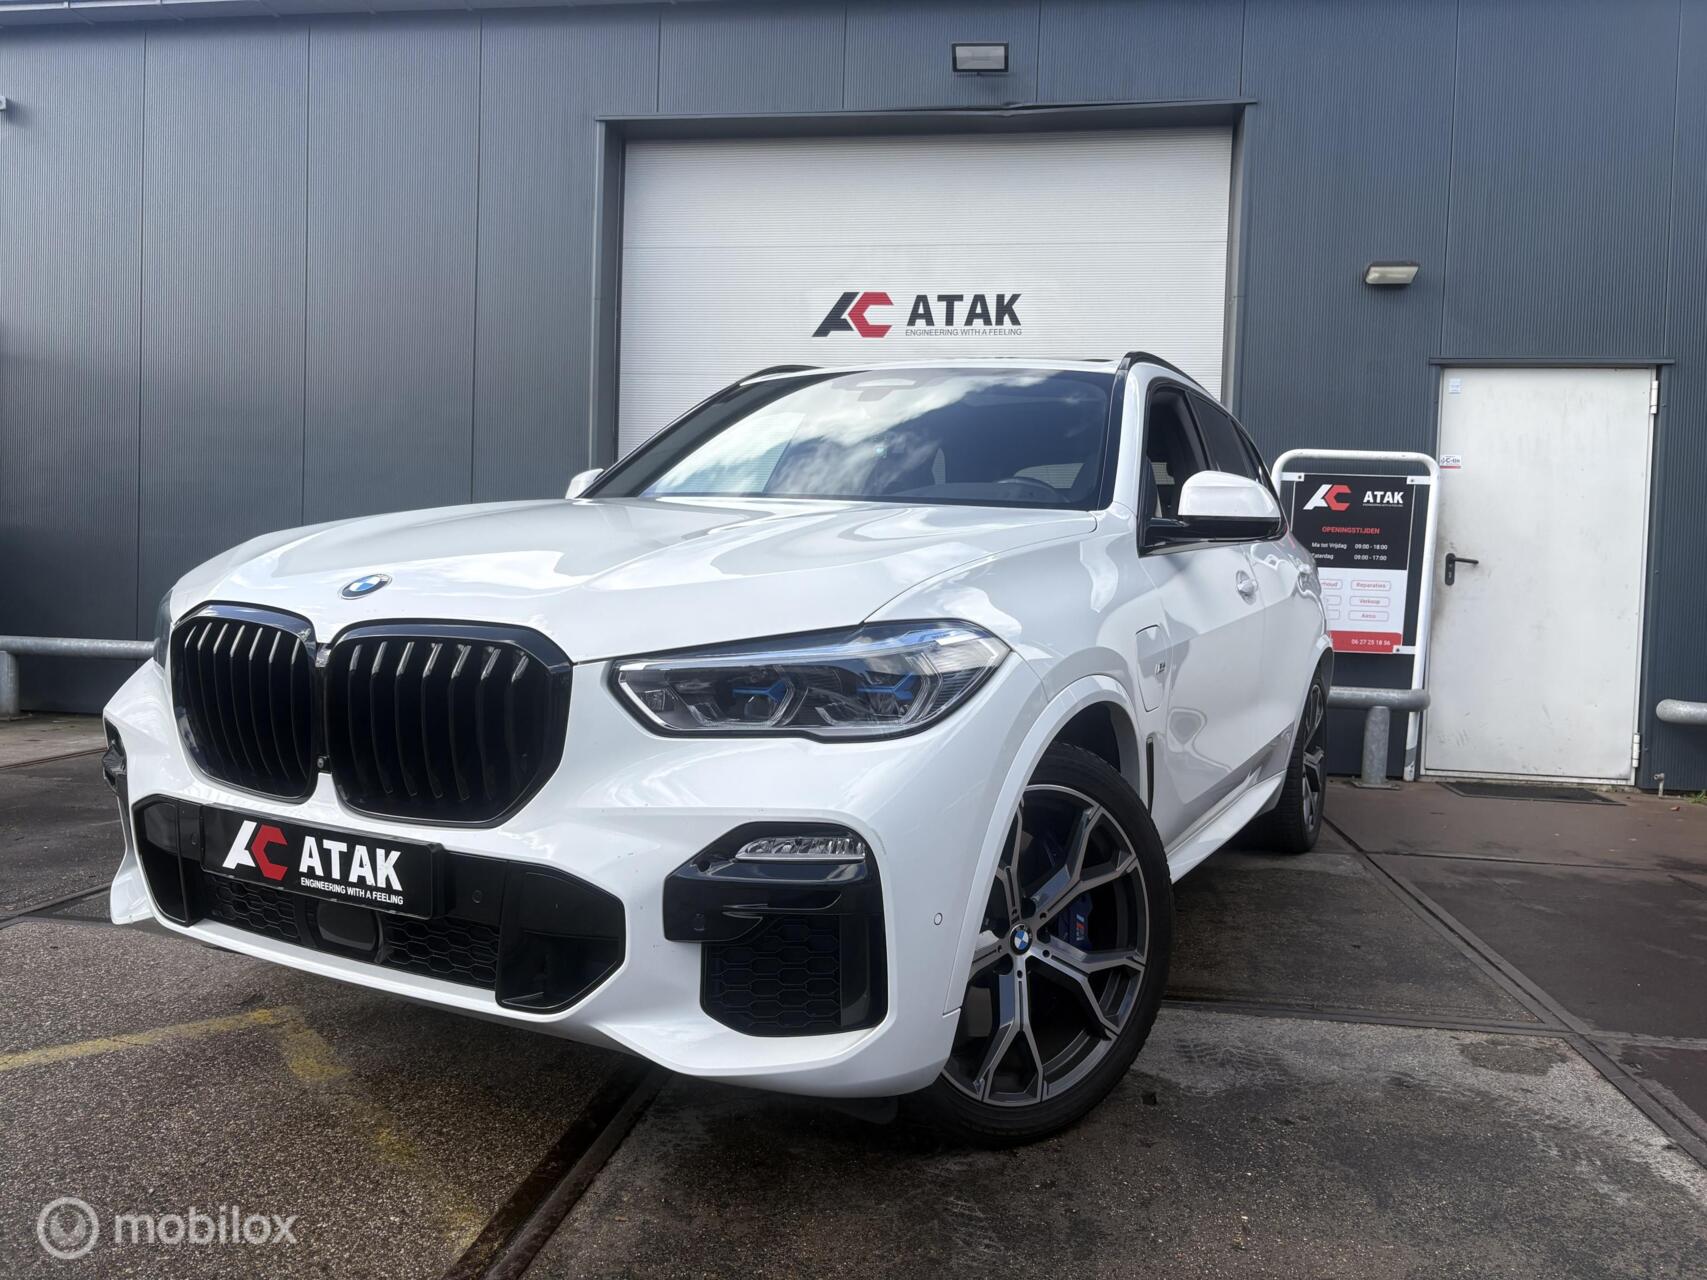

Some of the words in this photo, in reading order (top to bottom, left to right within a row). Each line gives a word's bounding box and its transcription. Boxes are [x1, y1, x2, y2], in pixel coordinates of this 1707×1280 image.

[906, 293, 1022, 326] ATAK
[905, 329, 959, 337] ENGINEERING
[988, 328, 1022, 336] FEELING
[1362, 491, 1405, 504] ATAK
[1321, 526, 1381, 534] OPENINGSTIJDEN
[299, 835, 403, 892] ATAK
[300, 877, 346, 894] ENGINEERING
[346, 886, 365, 898] WITH
[365, 890, 372, 899] A
[372, 891, 404, 905] FEELING
